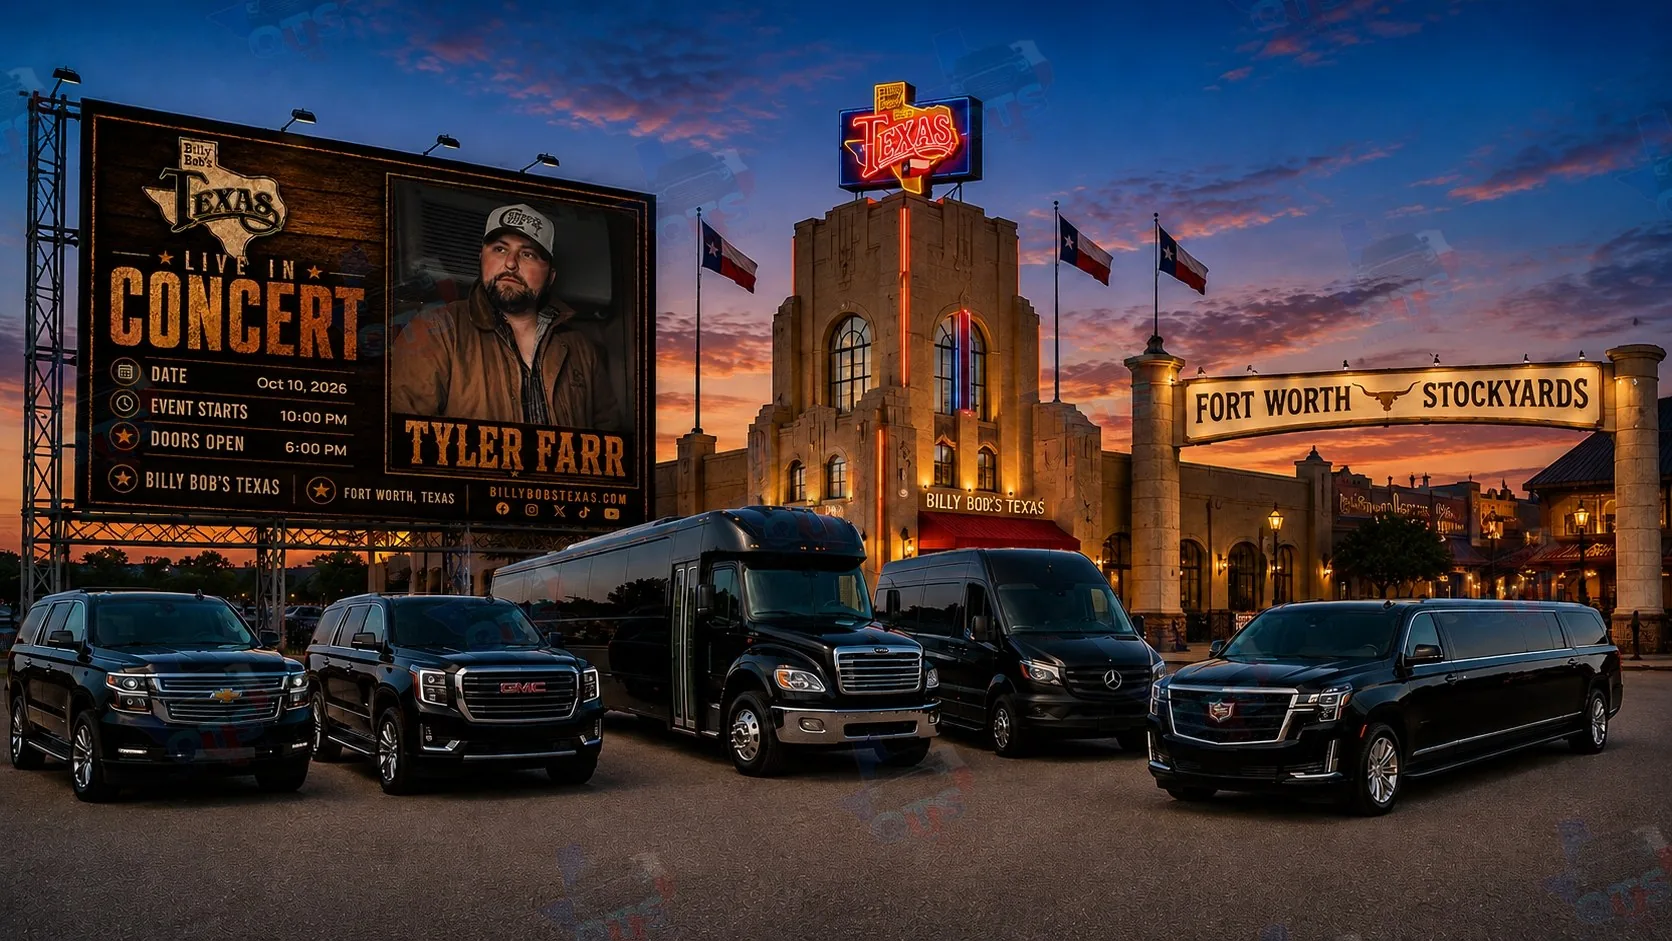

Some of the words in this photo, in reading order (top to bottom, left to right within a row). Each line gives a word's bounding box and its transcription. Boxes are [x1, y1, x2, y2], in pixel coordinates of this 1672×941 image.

[183, 142, 213, 160] Billy
[853, 114, 953, 178] TEXAS
[183, 154, 213, 168] Bob's
[159, 167, 283, 236] TEXAS
[185, 250, 246, 276] LIVE
[269, 259, 295, 280] IN
[110, 266, 365, 361] CONCERT
[151, 366, 188, 384] DATE
[256, 376, 284, 391] Oct
[287, 379, 307, 395] 10,
[310, 380, 348, 395] 2026
[151, 398, 193, 416] EVENT
[198, 401, 249, 420] STARTS
[279, 409, 321, 424] 10:00
[325, 413, 348, 426] PM
[1195, 390, 1256, 423] FORT
[1264, 384, 1352, 416] WORTH
[1422, 377, 1589, 410] STOCKYARDS
[151, 430, 200, 449] DOORS
[206, 434, 244, 452] OPEN
[285, 441, 320, 455] 6:00
[324, 444, 348, 456] PM
[405, 420, 525, 471] TYLER
[536, 430, 626, 477] FARR
[145, 471, 185, 489] BILLY
[190, 474, 231, 493] BOB'S
[236, 477, 280, 495] TEXAS
[344, 487, 372, 500] FORT
[376, 488, 417, 504] WORTH,
[421, 491, 455, 505] TEXAS
[489, 486, 628, 505] BILLYBOBSTEXAS.COM
[926, 492, 962, 510] BILLY
[1005, 498, 1045, 515] TEXAS
[500, 682, 546, 693] GMC
